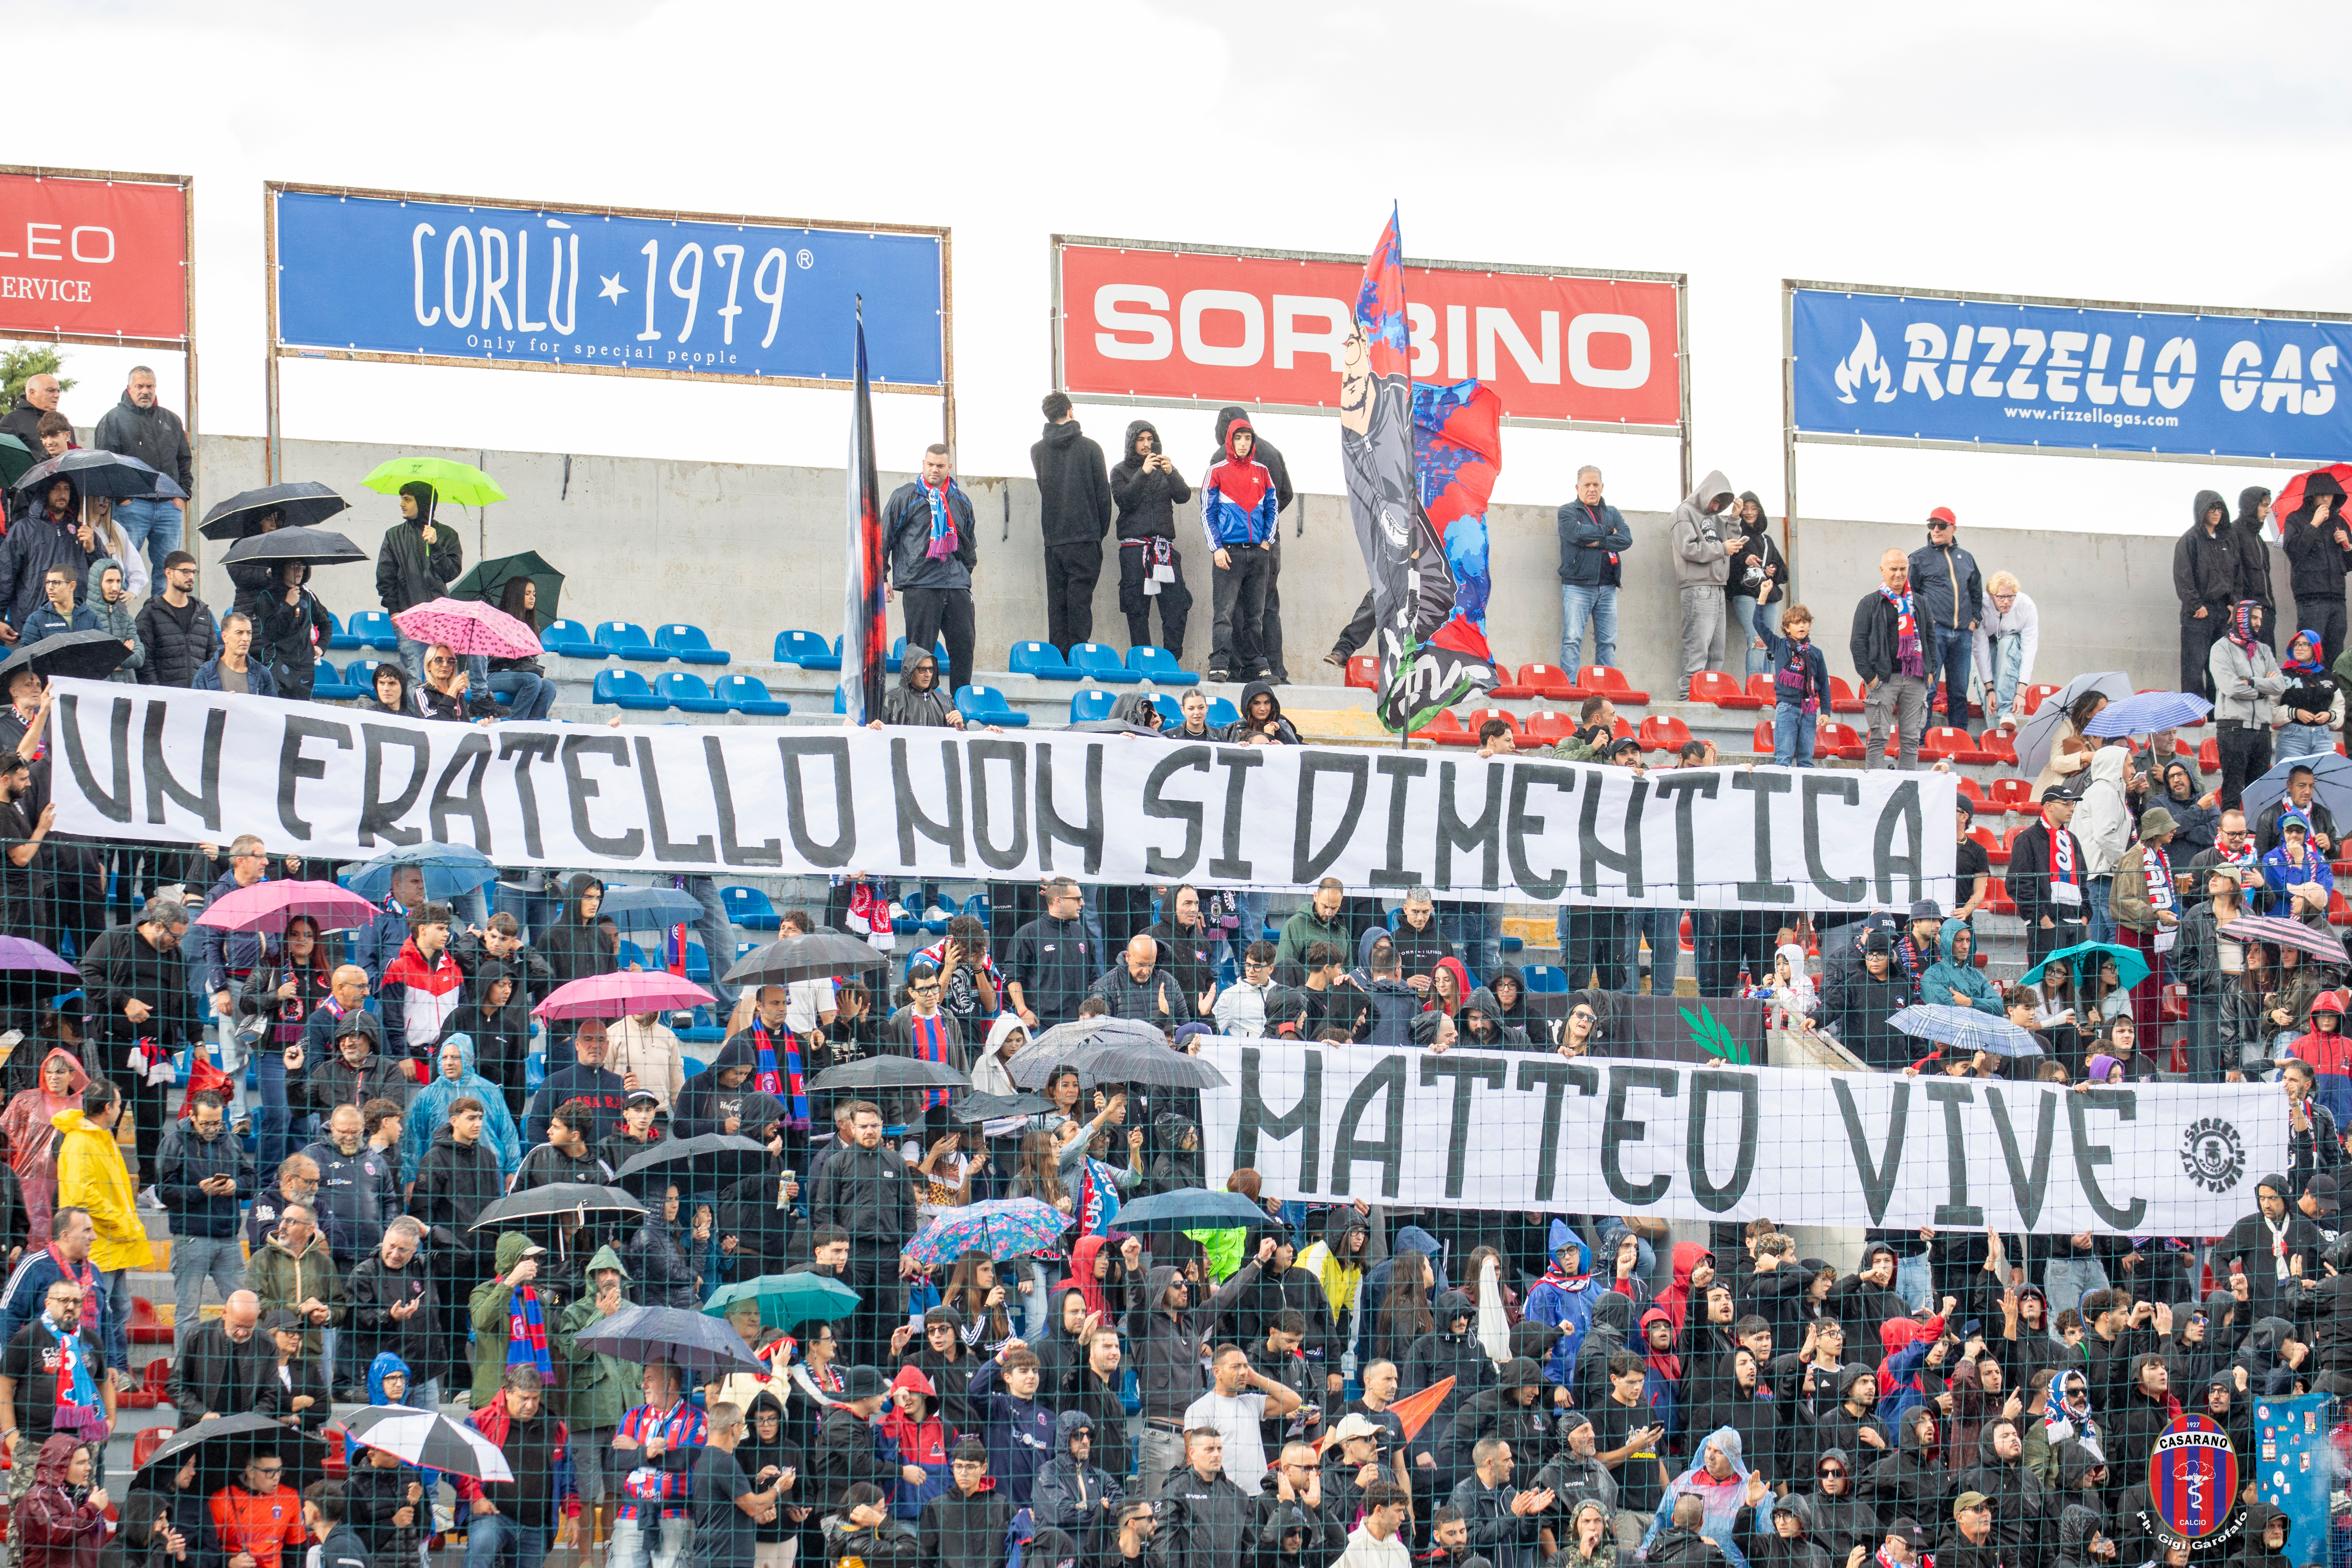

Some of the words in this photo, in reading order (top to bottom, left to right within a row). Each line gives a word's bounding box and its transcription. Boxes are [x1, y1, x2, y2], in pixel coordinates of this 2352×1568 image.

[0, 276, 91, 302] ERVICE
[413, 219, 578, 335] CORLÙ
[467, 335, 516, 353] Only
[530, 338, 560, 353] for
[574, 342, 653, 359] special
[667, 351, 737, 365] people
[1902, 322, 2196, 410] RIZZELLO
[2220, 340, 2337, 415] GAS
[2004, 406, 2178, 428] www.rizzellogas.com
[60, 694, 226, 832] UN
[279, 714, 856, 868] FRATELLO
[891, 737, 1103, 875] NON
[1144, 746, 1263, 880] SI
[1293, 752, 1922, 904] DIMENTICA
[720, 1101, 742, 1111] Hard
[1234, 1047, 1757, 1213] MATTEO
[1831, 1077, 2146, 1231] VIVE
[2184, 1117, 2241, 1142] STREET
[2179, 1149, 2246, 1193] MENTALITY
[2199, 1158, 2228, 1173] CASARANO
